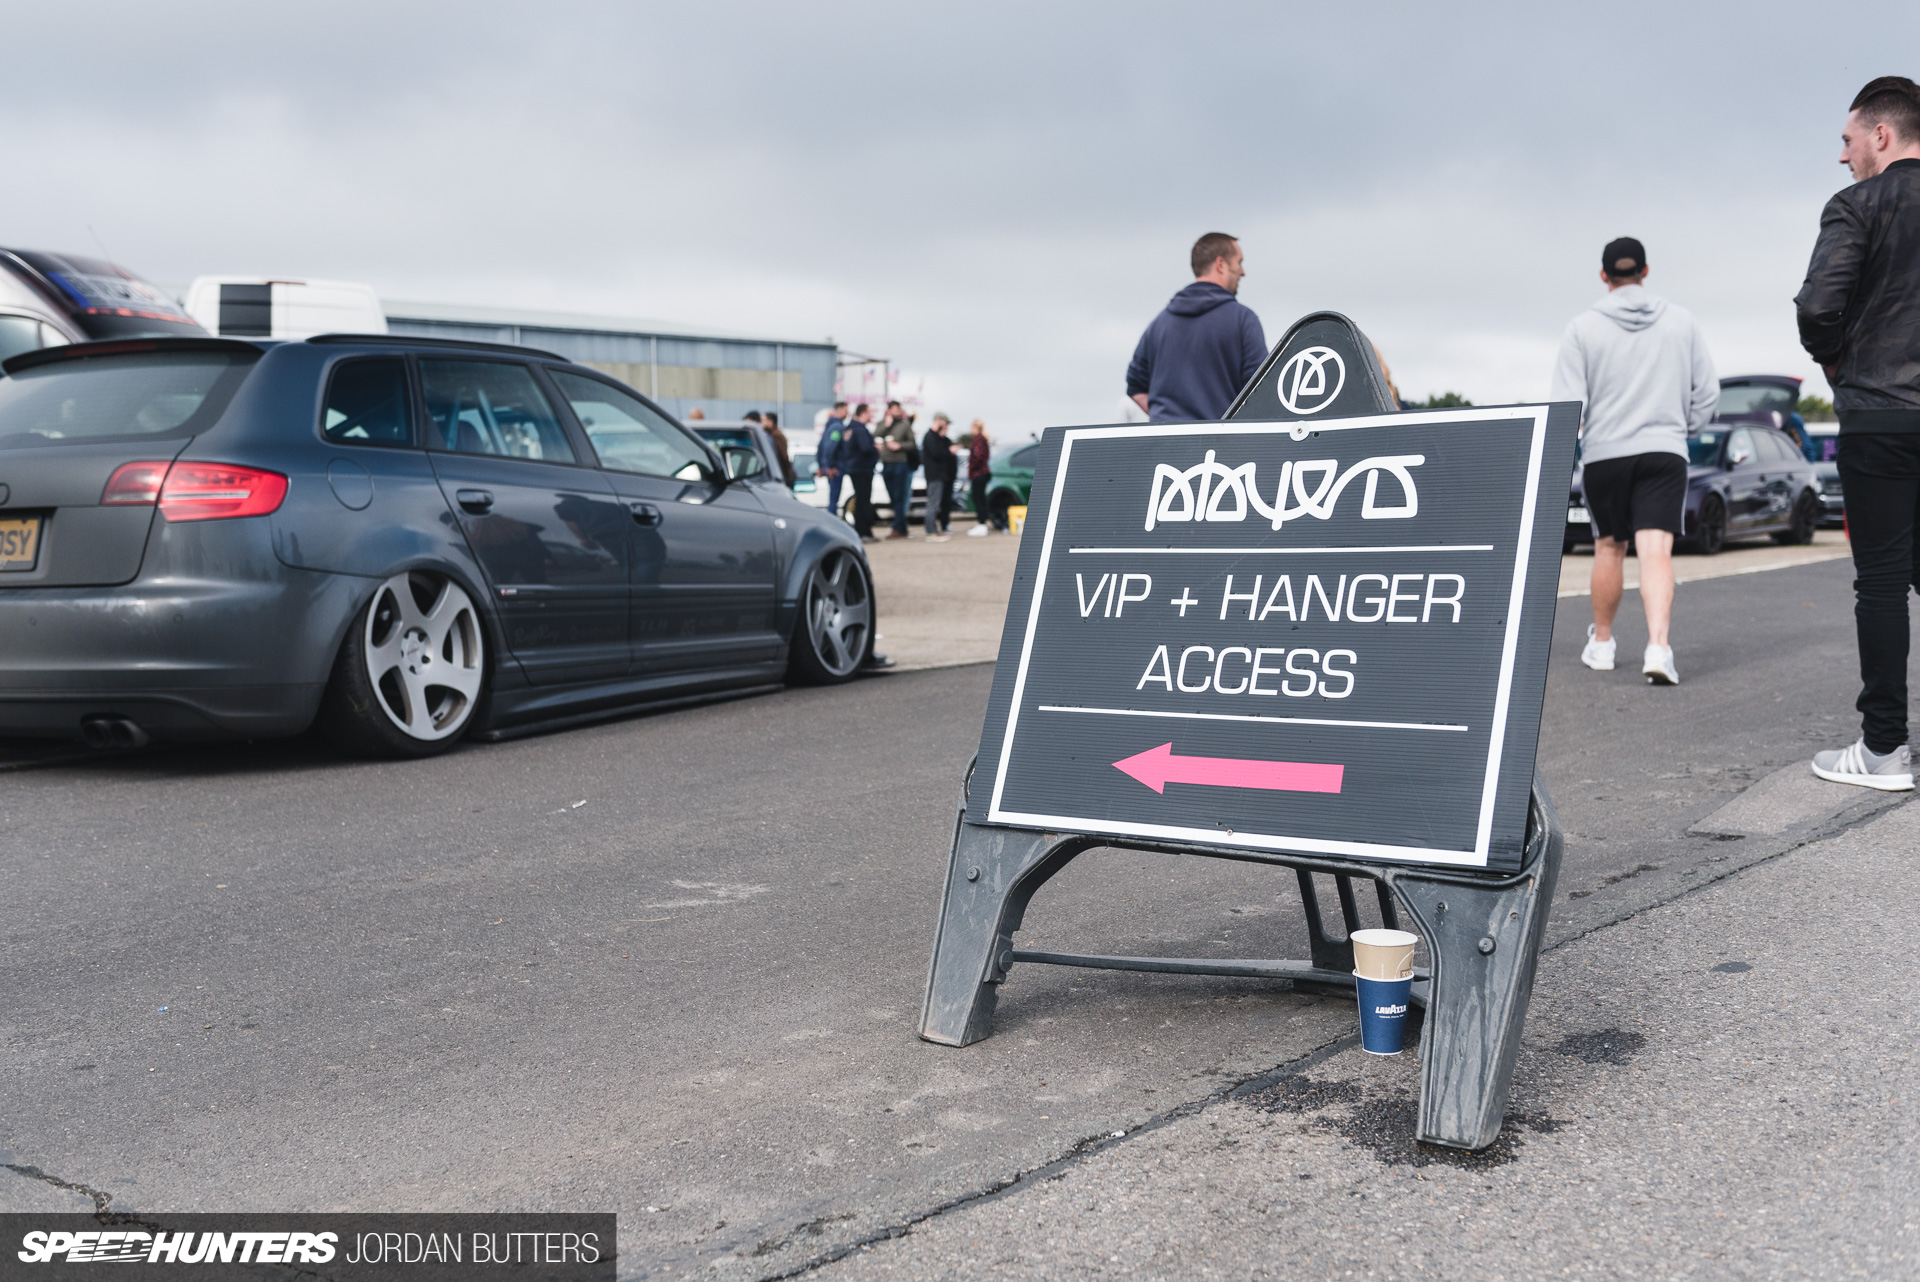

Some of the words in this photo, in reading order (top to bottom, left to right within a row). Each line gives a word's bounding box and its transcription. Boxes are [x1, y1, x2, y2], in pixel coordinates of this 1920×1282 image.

[1076, 574, 1152, 617] VIP
[1171, 588, 1198, 617] +
[1220, 574, 1465, 623] HANGER
[1136, 645, 1357, 698] ACCESS
